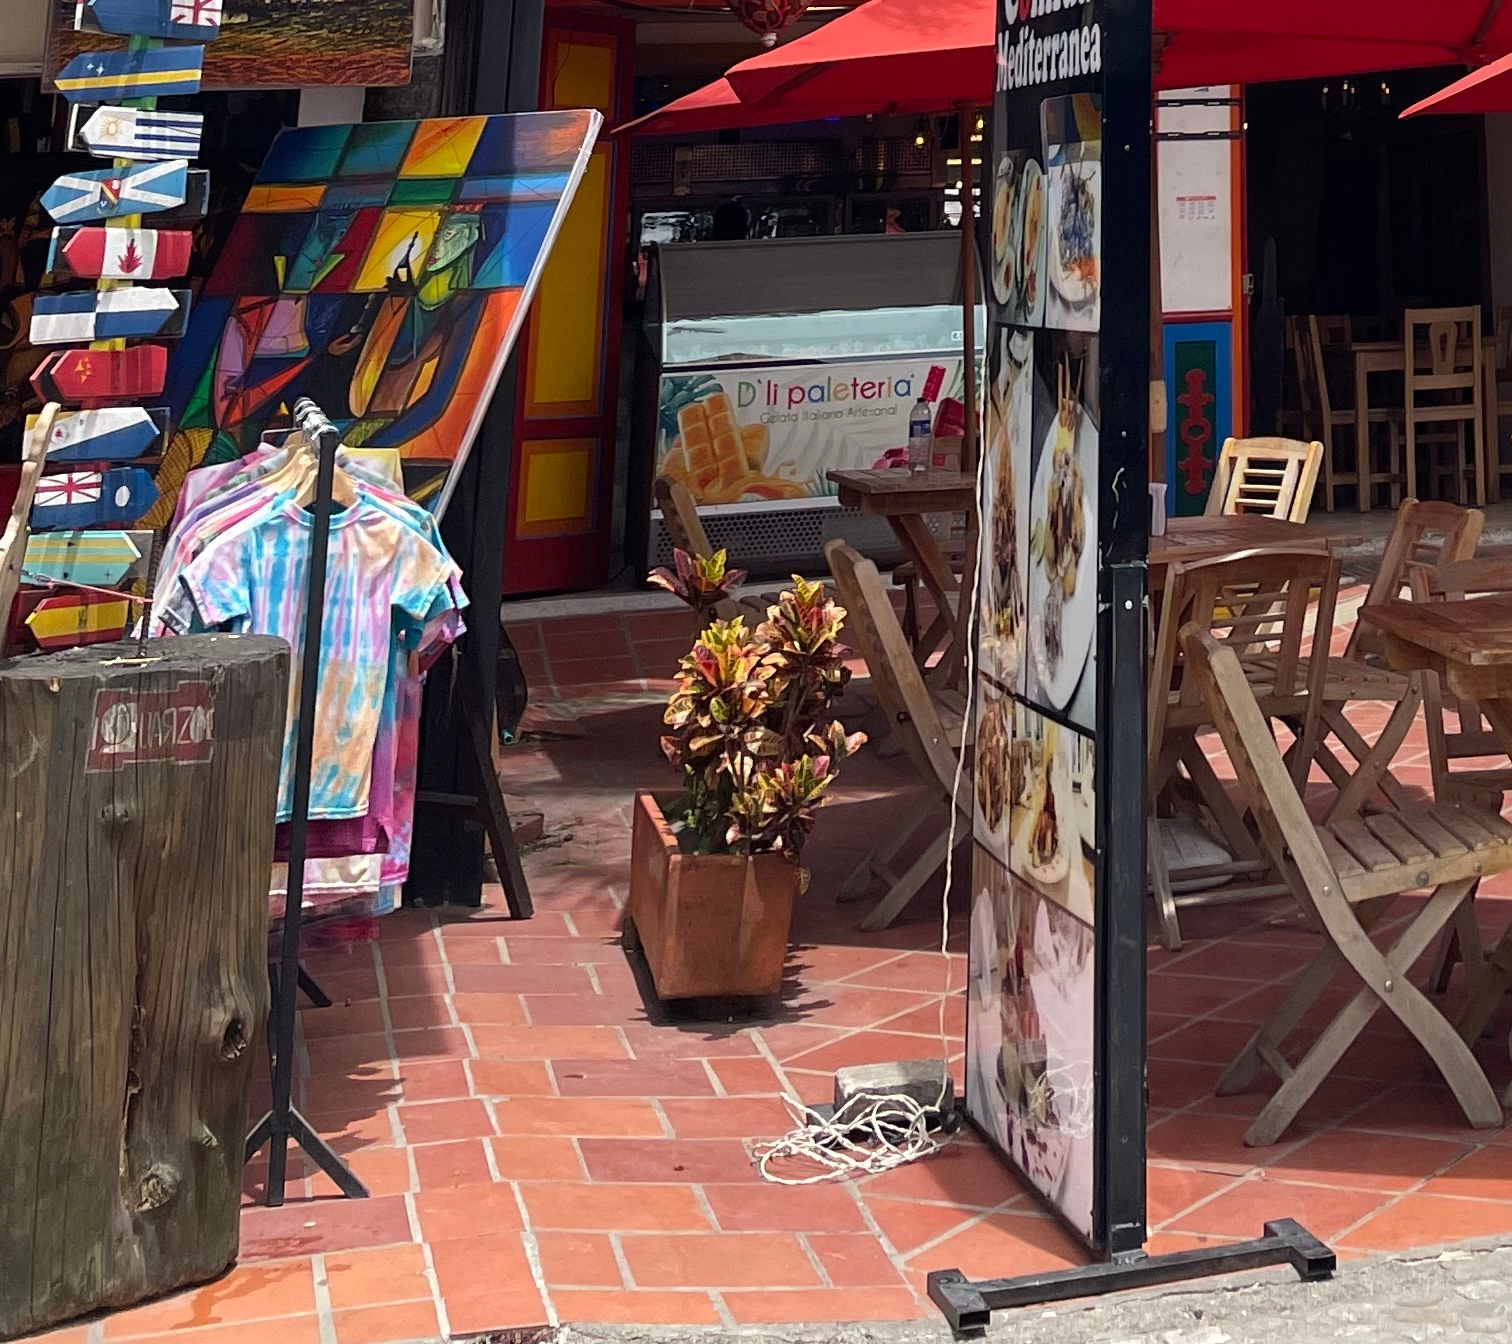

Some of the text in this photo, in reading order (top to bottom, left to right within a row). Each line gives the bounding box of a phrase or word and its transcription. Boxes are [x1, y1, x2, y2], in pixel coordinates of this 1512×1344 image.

[996, 23, 1101, 93] Mediterranea
[760, 404, 898, 425] Gelato Italiano Artesanal
